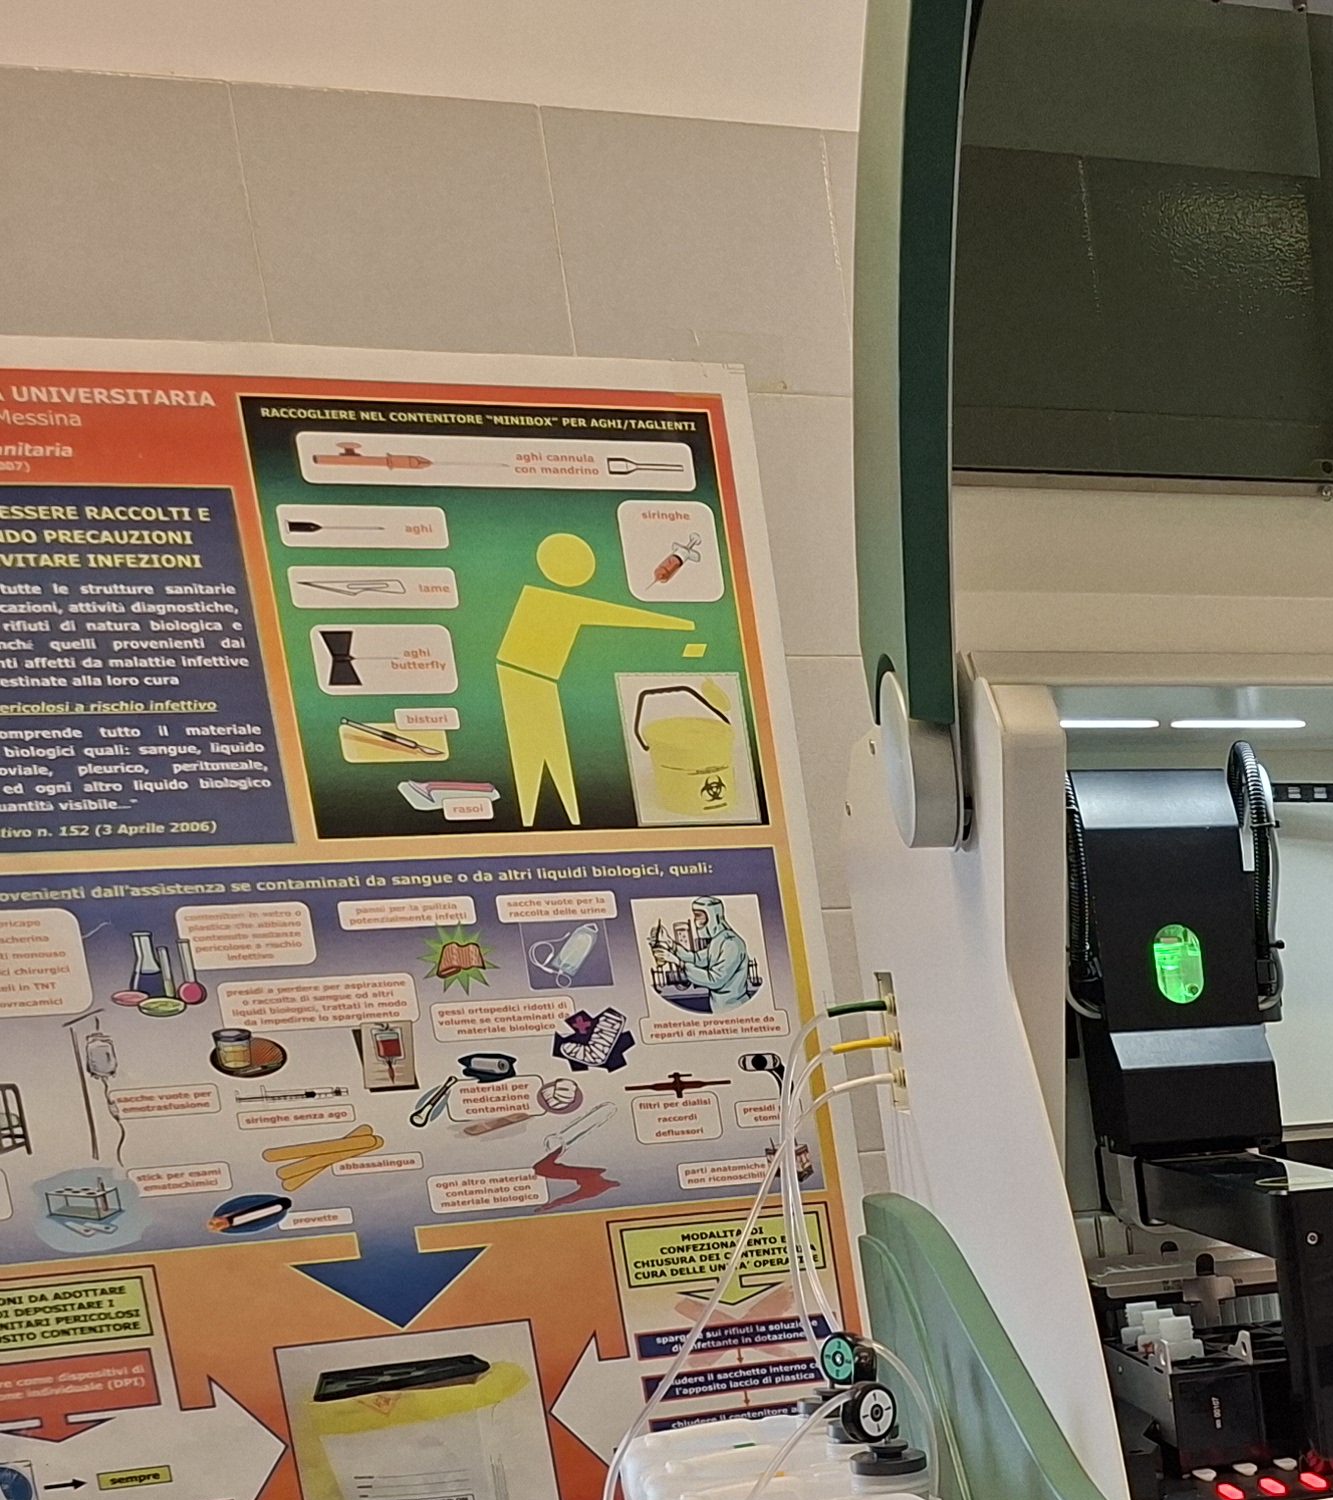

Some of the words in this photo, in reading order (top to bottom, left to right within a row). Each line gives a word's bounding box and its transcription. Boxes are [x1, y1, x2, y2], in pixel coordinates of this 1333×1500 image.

[11, 386, 216, 407] UNIVERSITARIA
[261, 407, 357, 421] RACCOGLIERE
[361, 411, 386, 421] NEL
[390, 412, 483, 424] CONTENITORE
[562, 418, 587, 428] PER
[516, 453, 542, 463] aghi
[547, 453, 594, 463] cannula
[515, 466, 536, 474] con
[541, 465, 599, 475] mandrino
[85, 507, 192, 521] RACCOLTI
[642, 510, 690, 521] siringhe
[405, 524, 432, 535] aghi
[44, 530, 193, 545] PRECAUZIONI
[87, 554, 203, 568] INFEZIONI
[81, 584, 154, 595] strutture
[165, 583, 236, 595] sanitarie
[419, 584, 450, 593] lame
[131, 601, 238, 616] diagnostiche,
[3, 621, 49, 632] rifiuti
[86, 622, 140, 631] natura
[150, 620, 222, 633] biologica
[50, 638, 96, 651] quelli
[113, 638, 205, 652] provenienti
[403, 648, 430, 659] aghi
[109, 656, 175, 668] malattie
[182, 655, 249, 668] infettive
[391, 660, 446, 671] butterfly
[72, 676, 102, 686] alla
[107, 675, 139, 686] loro
[144, 676, 179, 686] cura
[90, 701, 144, 712] rischio
[150, 699, 217, 711] infettivo
[407, 715, 448, 724] bisturi
[100, 726, 141, 738] tutto
[186, 724, 261, 736] materiale
[210, 742, 265, 755] liquido
[84, 782, 122, 792] altro
[134, 780, 188, 793] liquido
[453, 804, 483, 813] rasoi
[60, 824, 90, 837] 152
[117, 822, 165, 836] Aprile
[170, 819, 217, 834] 2006)
[256, 875, 360, 891] contaminati
[392, 871, 453, 887] sangue
[499, 867, 532, 881] altri
[537, 866, 587, 882] liquidi
[592, 863, 664, 879] biologici,
[670, 862, 712, 876] quali:
[468, 1005, 520, 1015] ortopedici
[524, 1003, 554, 1011] ridotti
[439, 1017, 476, 1026] volume
[494, 1014, 554, 1023] contaminati
[654, 1020, 700, 1029] materiale
[703, 1016, 761, 1027] proveniente
[458, 1024, 506, 1035] materiale
[510, 1023, 555, 1032] biologico
[650, 1030, 684, 1039] reparti
[699, 1027, 738, 1036] malattie
[741, 1025, 781, 1033] infettive
[460, 1083, 507, 1094] materiali
[512, 1083, 529, 1092] per
[463, 1094, 529, 1104] medicazione
[639, 1100, 660, 1109] filtri
[664, 1100, 679, 1110] per
[466, 1104, 529, 1115] contaminati
[246, 1113, 290, 1125] siringhe
[293, 1111, 324, 1120] senza
[328, 1110, 347, 1119] ago
[658, 1113, 697, 1123] raccordi
[656, 1127, 703, 1138] deflussori
[339, 1158, 415, 1171] abbassalingua
[685, 1165, 707, 1176] parti
[436, 1179, 459, 1189] ogni
[461, 1178, 486, 1187] altro
[688, 1176, 705, 1184] non
[446, 1186, 511, 1198] contaminato
[513, 1183, 530, 1192] con
[441, 1197, 490, 1208] materiale
[493, 1193, 539, 1204] biologico
[293, 1213, 338, 1225] provette
[634, 1256, 696, 1269] CHIUSURA
[700, 1253, 721, 1262] DEI
[635, 1268, 666, 1280] CURA
[670, 1266, 706, 1277] DELLE
[53, 1286, 126, 1300] ADOTTARE
[15, 1301, 103, 1317] DEPOSITARE
[56, 1309, 140, 1325] PERICOLOSI
[41, 1322, 140, 1338] CONTENITORE
[718, 1367, 768, 1380] sacchetto
[769, 1363, 805, 1375] interno
[775, 1371, 815, 1384] plastica
[110, 1472, 160, 1485] sempre
